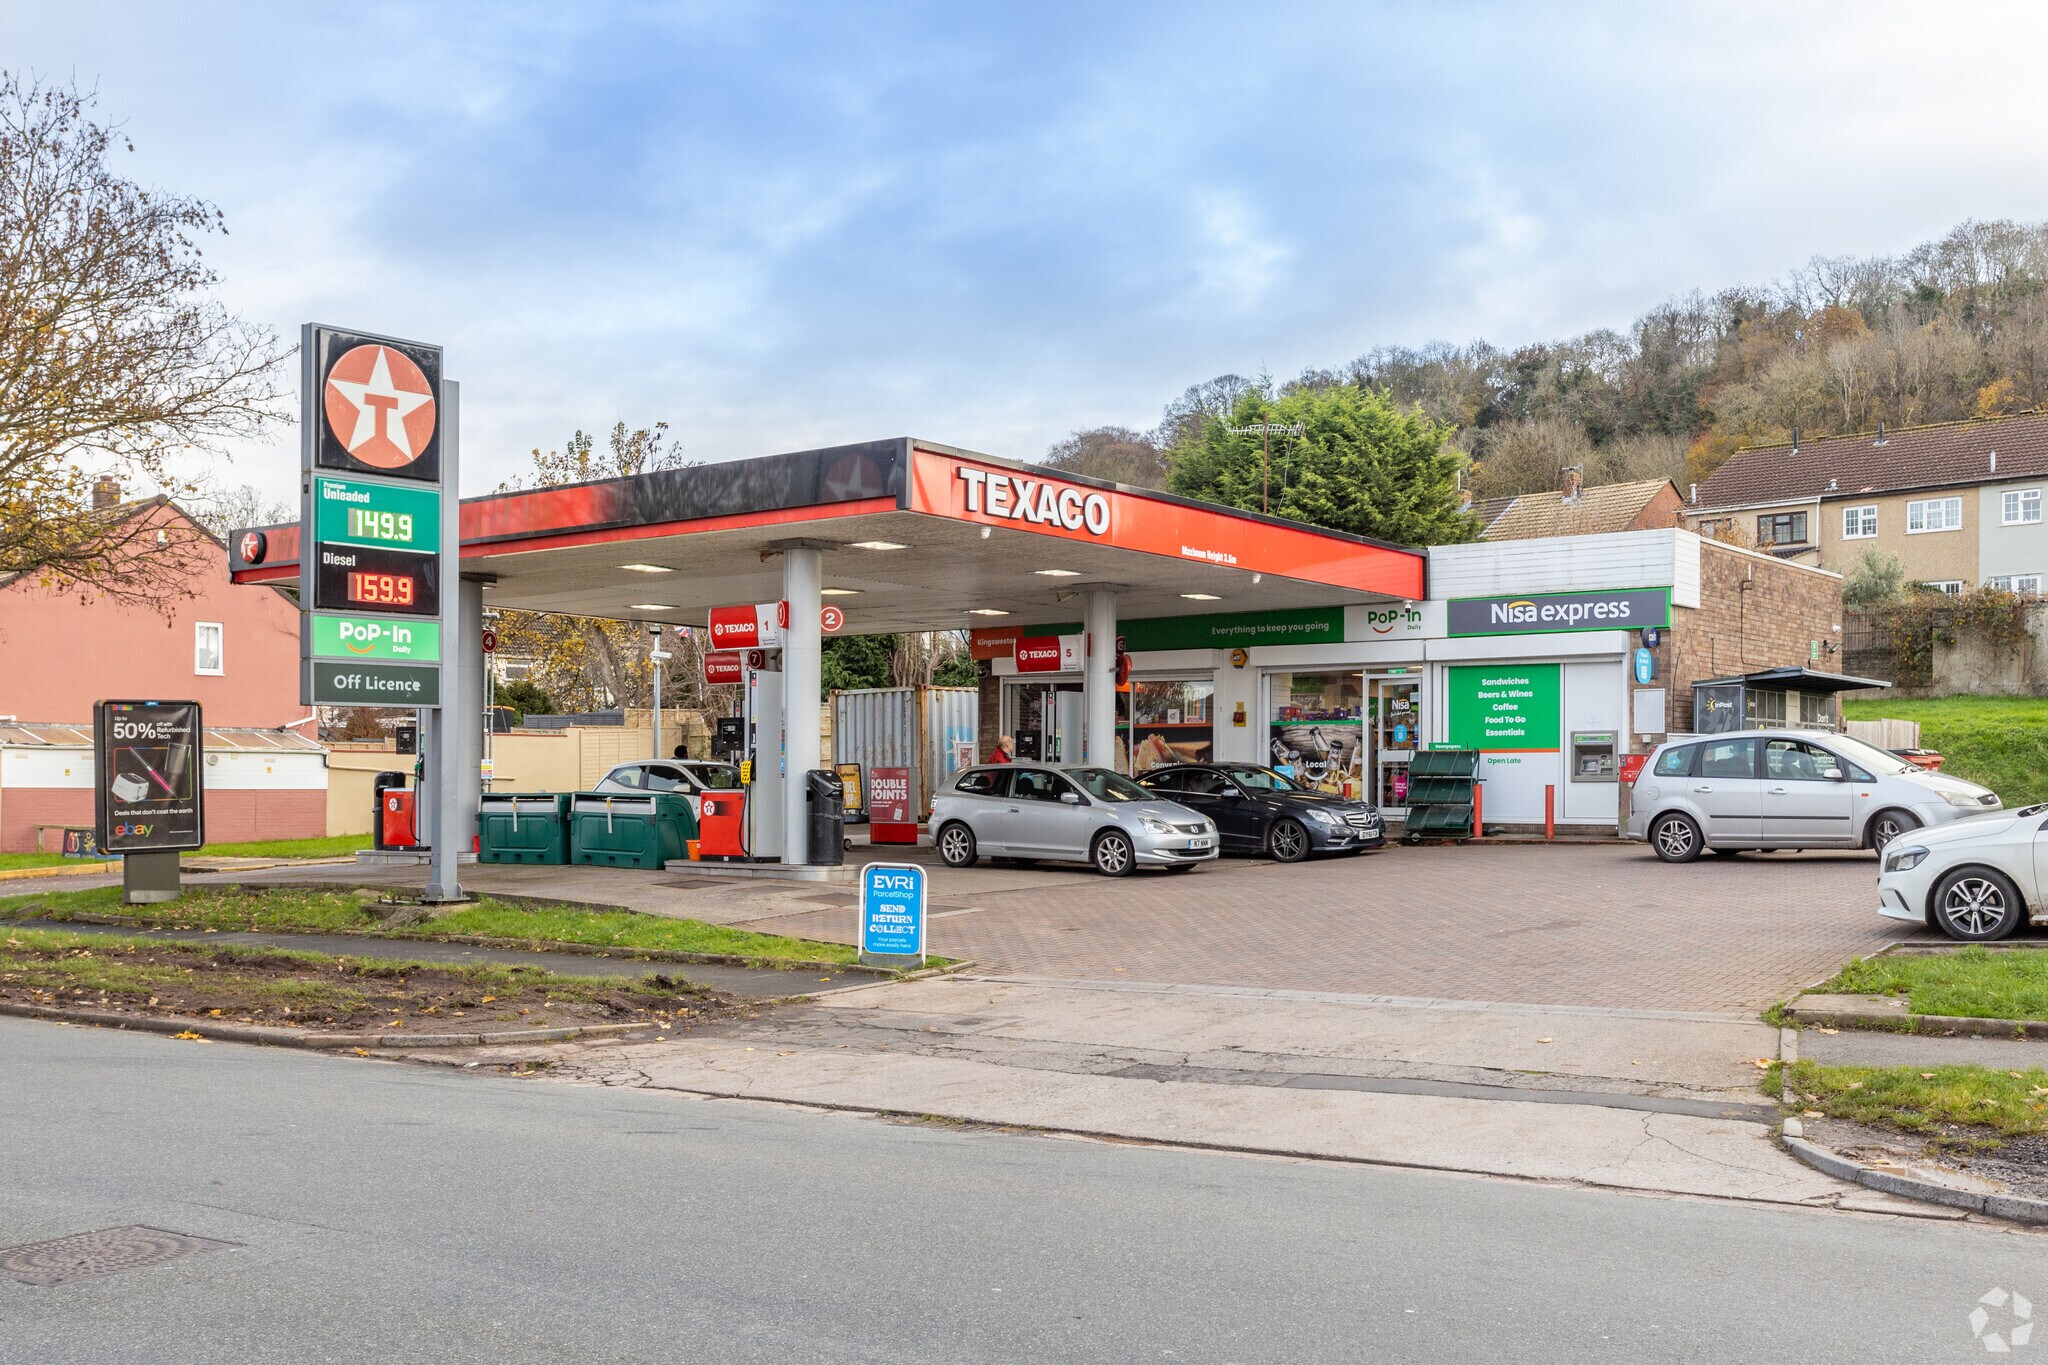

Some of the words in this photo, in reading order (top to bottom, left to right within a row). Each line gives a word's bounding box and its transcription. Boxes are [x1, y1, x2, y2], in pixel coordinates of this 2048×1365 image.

[323, 482, 346, 490] Premium
[323, 488, 370, 504] Unleaded
[958, 466, 1110, 536] TEXACO
[356, 510, 412, 541] 149.9
[323, 552, 356, 566] Diesel
[1182, 546, 1206, 559] Maximum
[1206, 550, 1223, 563] Height
[1224, 553, 1237, 564] 3.6m
[356, 574, 412, 603] 159.9
[825, 612, 836, 624] 2
[1491, 601, 1538, 624] Nisa
[1541, 601, 1630, 625] express
[725, 623, 754, 633] TEXACO
[764, 620, 769, 630] 1
[1212, 625, 1256, 636] Everything
[1257, 624, 1265, 633] to
[1266, 624, 1287, 634] keep
[1288, 624, 1304, 634] you
[1304, 622, 1330, 633] going
[340, 622, 412, 643] PoP-In
[486, 636, 492, 646] 4
[1117, 641, 1124, 650] 6
[393, 645, 412, 654] Daily
[1029, 650, 1058, 659] TEXACO
[1066, 649, 1072, 657] 5
[752, 654, 758, 663] 7
[334, 674, 362, 690] Off
[366, 676, 421, 691] Licence
[1482, 677, 1529, 686] Sandwiches
[1392, 699, 1409, 710] Nisa
[1492, 703, 1518, 711] Coffee
[114, 723, 156, 739] 50%
[1486, 728, 1525, 737] Essentials
[871, 779, 906, 789] DOUBLE
[846, 794, 854, 805] UP
[871, 790, 907, 800] POINTS
[115, 822, 154, 838] ebay
[874, 875, 913, 890] EVRi
[873, 890, 913, 900] ParcelShop
[880, 904, 906, 913] SEND
[872, 914, 913, 924] RETURN
[869, 924, 915, 934] COLLECT
